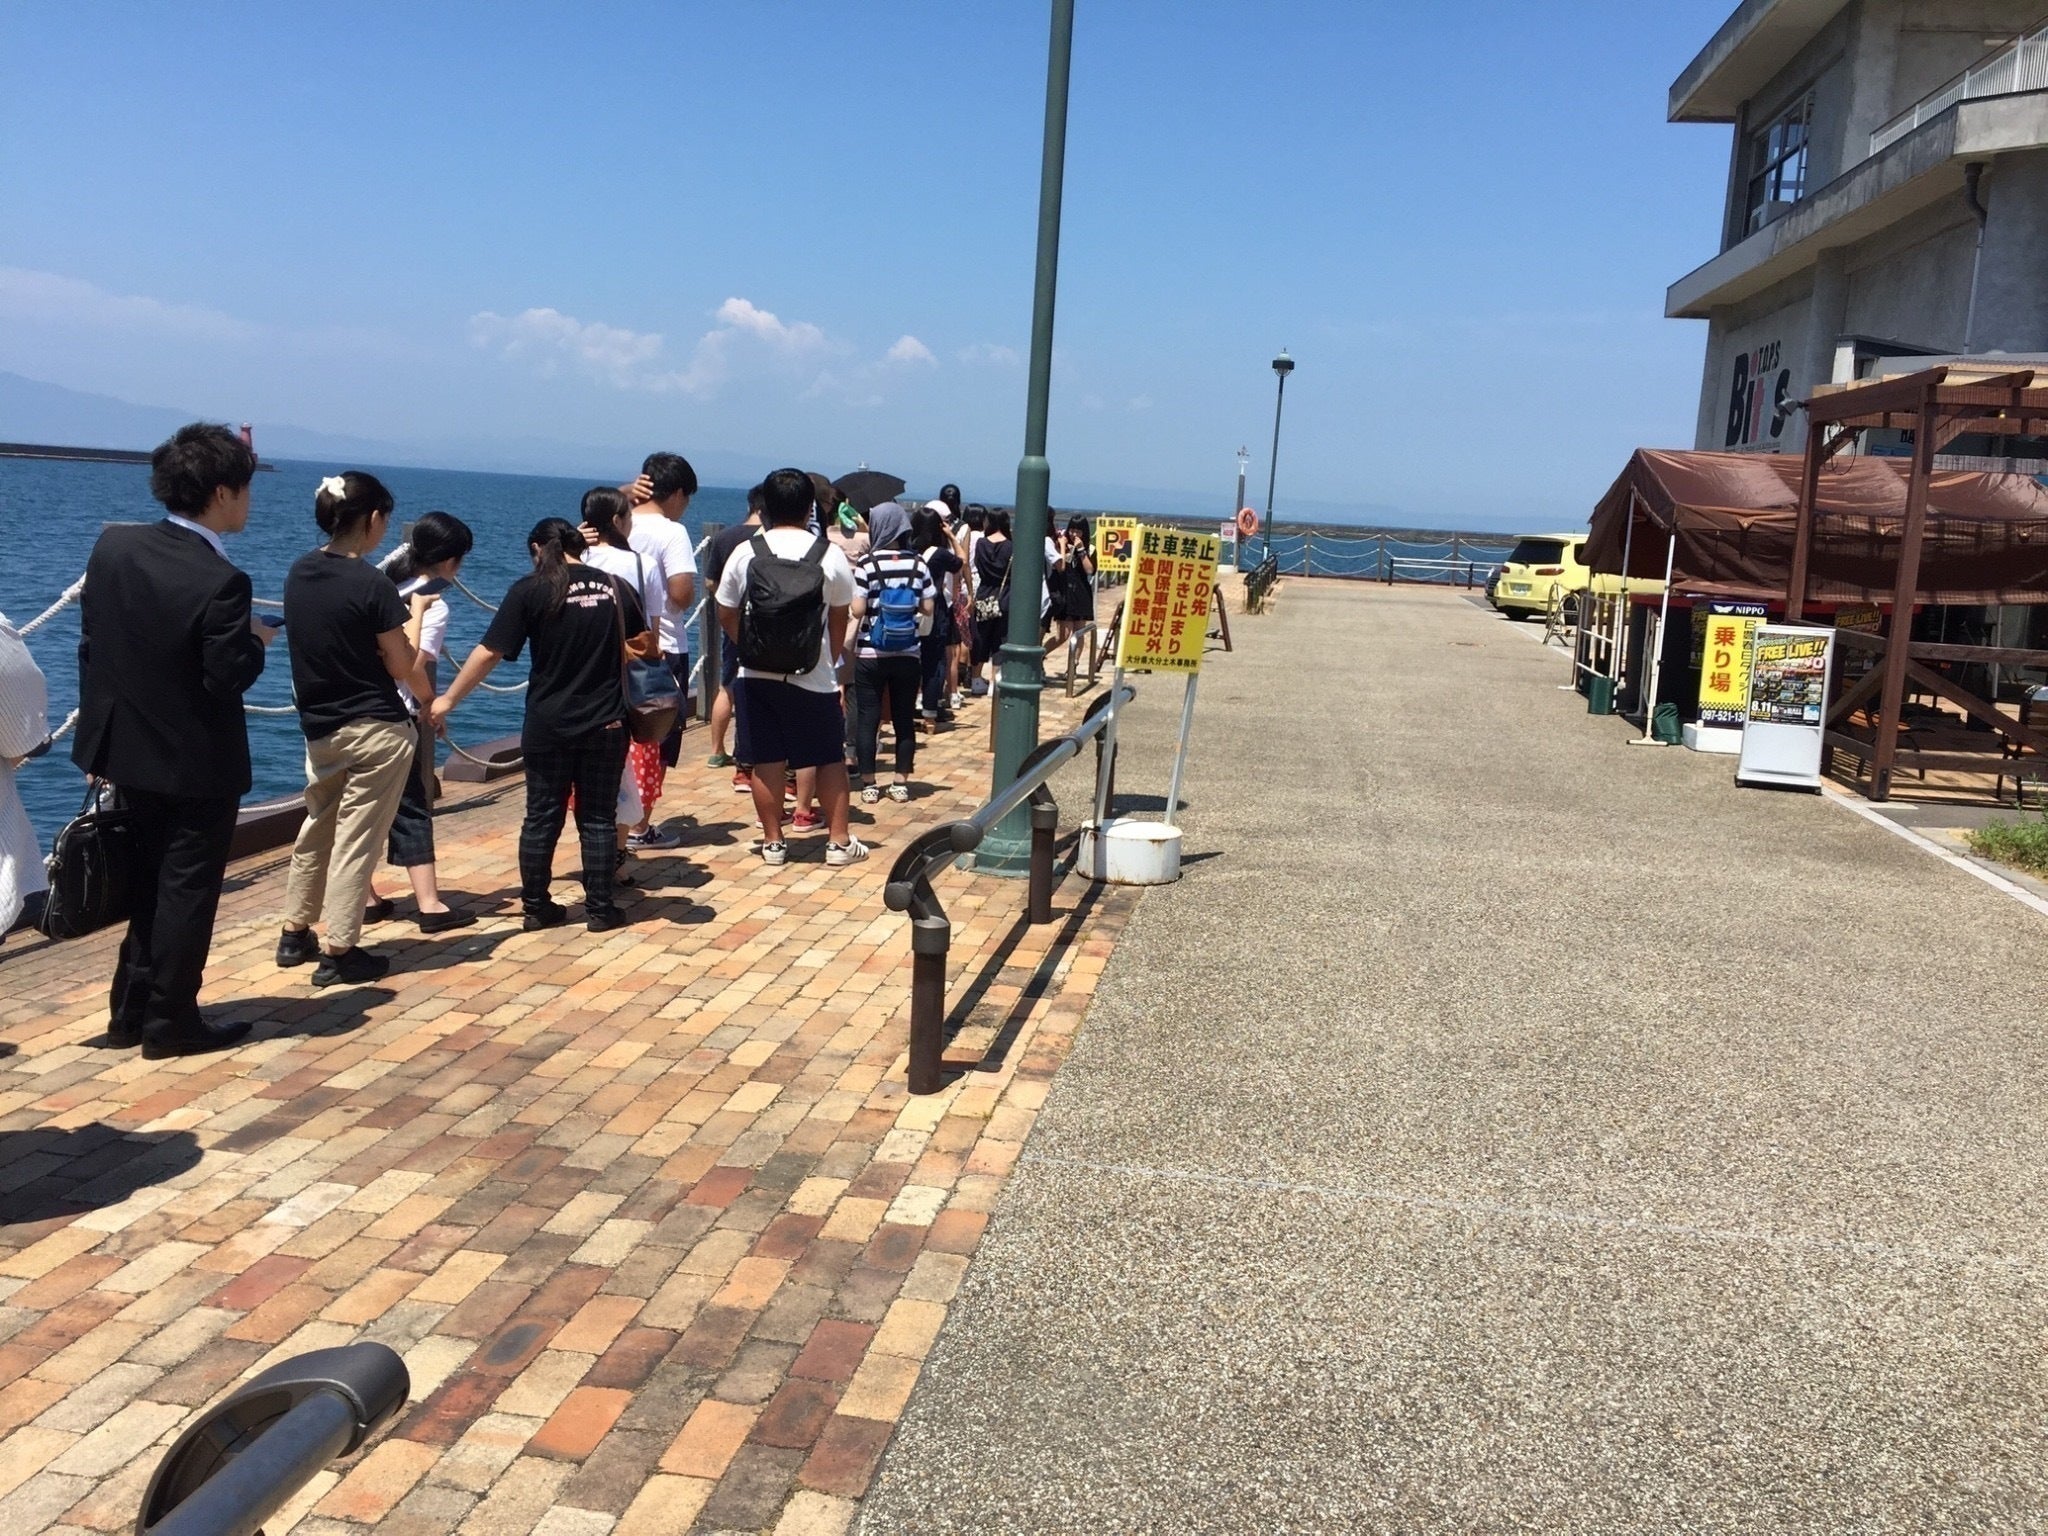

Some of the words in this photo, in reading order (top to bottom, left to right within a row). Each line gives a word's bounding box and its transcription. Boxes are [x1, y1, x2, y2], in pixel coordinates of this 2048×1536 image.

[1142, 532, 1215, 562] 駐車禁止
[1129, 557, 1154, 636] 進入禁止
[1168, 562, 1194, 655] 行き止まり
[1191, 564, 1210, 617] この先
[1735, 606, 1765, 615] NIPPO
[1709, 627, 1736, 693] 乗り場
[1757, 645, 1786, 661] FREE
[1788, 640, 1827, 659] LIVE!!
[1751, 700, 1772, 712] 8.11
